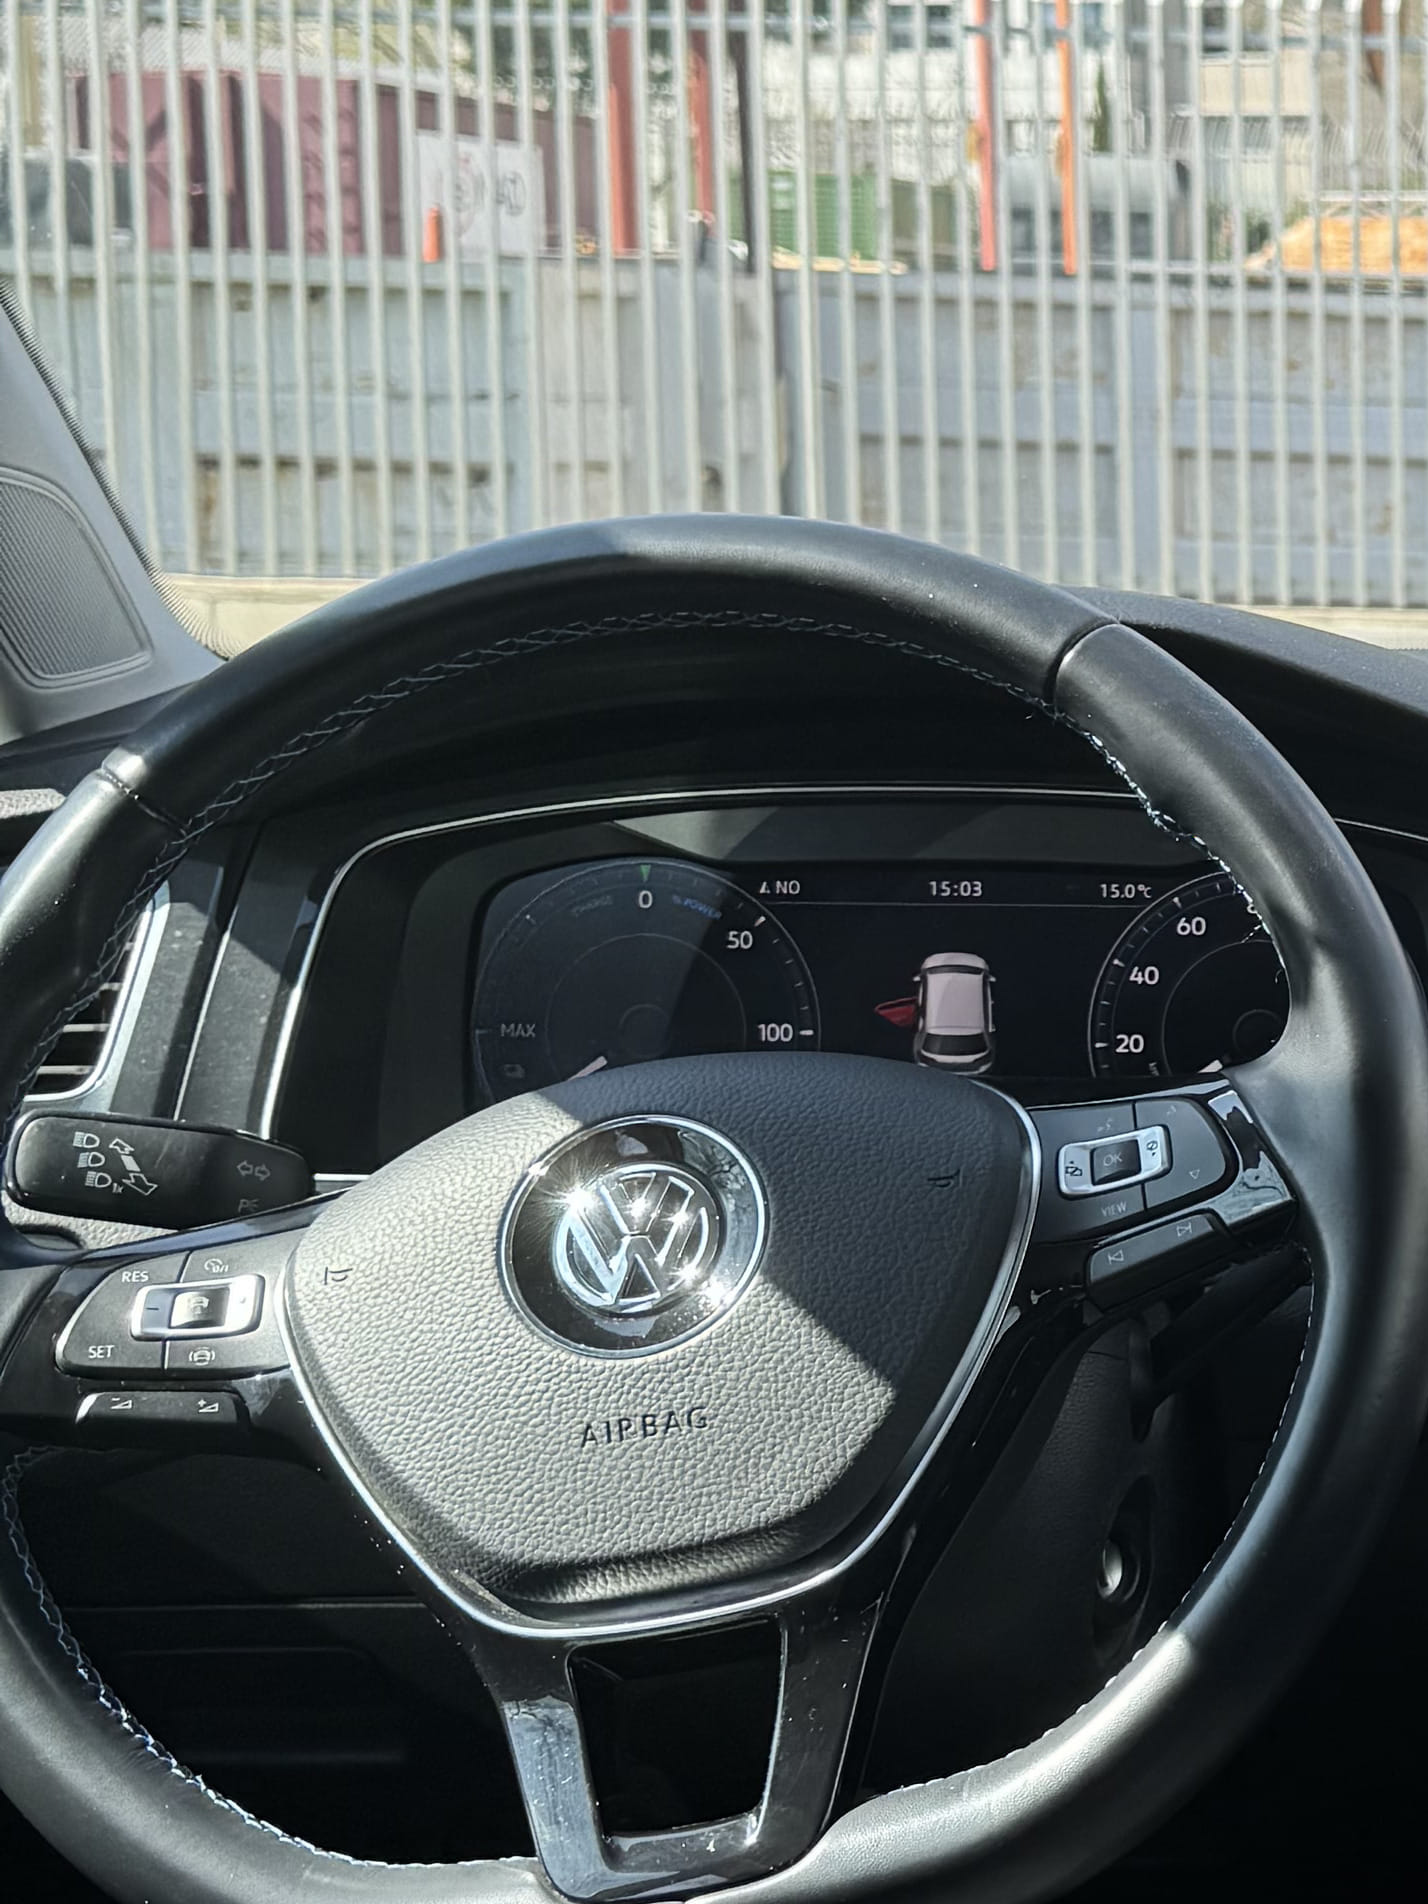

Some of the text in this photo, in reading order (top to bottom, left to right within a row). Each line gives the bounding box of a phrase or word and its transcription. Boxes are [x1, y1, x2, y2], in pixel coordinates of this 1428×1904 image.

[775, 879, 801, 895] NO
[928, 881, 983, 897] 15:03
[638, 890, 654, 909] 0
[1175, 916, 1207, 936] 60
[726, 930, 754, 950] 50
[1128, 966, 1160, 986] 40
[500, 1022, 536, 1039] MAX
[757, 1022, 794, 1043] 100
[1115, 1034, 1145, 1054] 20
[1103, 1152, 1123, 1167] OK
[1101, 1201, 1127, 1217] VIEW
[121, 1270, 149, 1283] RES
[88, 1345, 115, 1359] SET
[581, 1406, 708, 1447] AIRBAG
